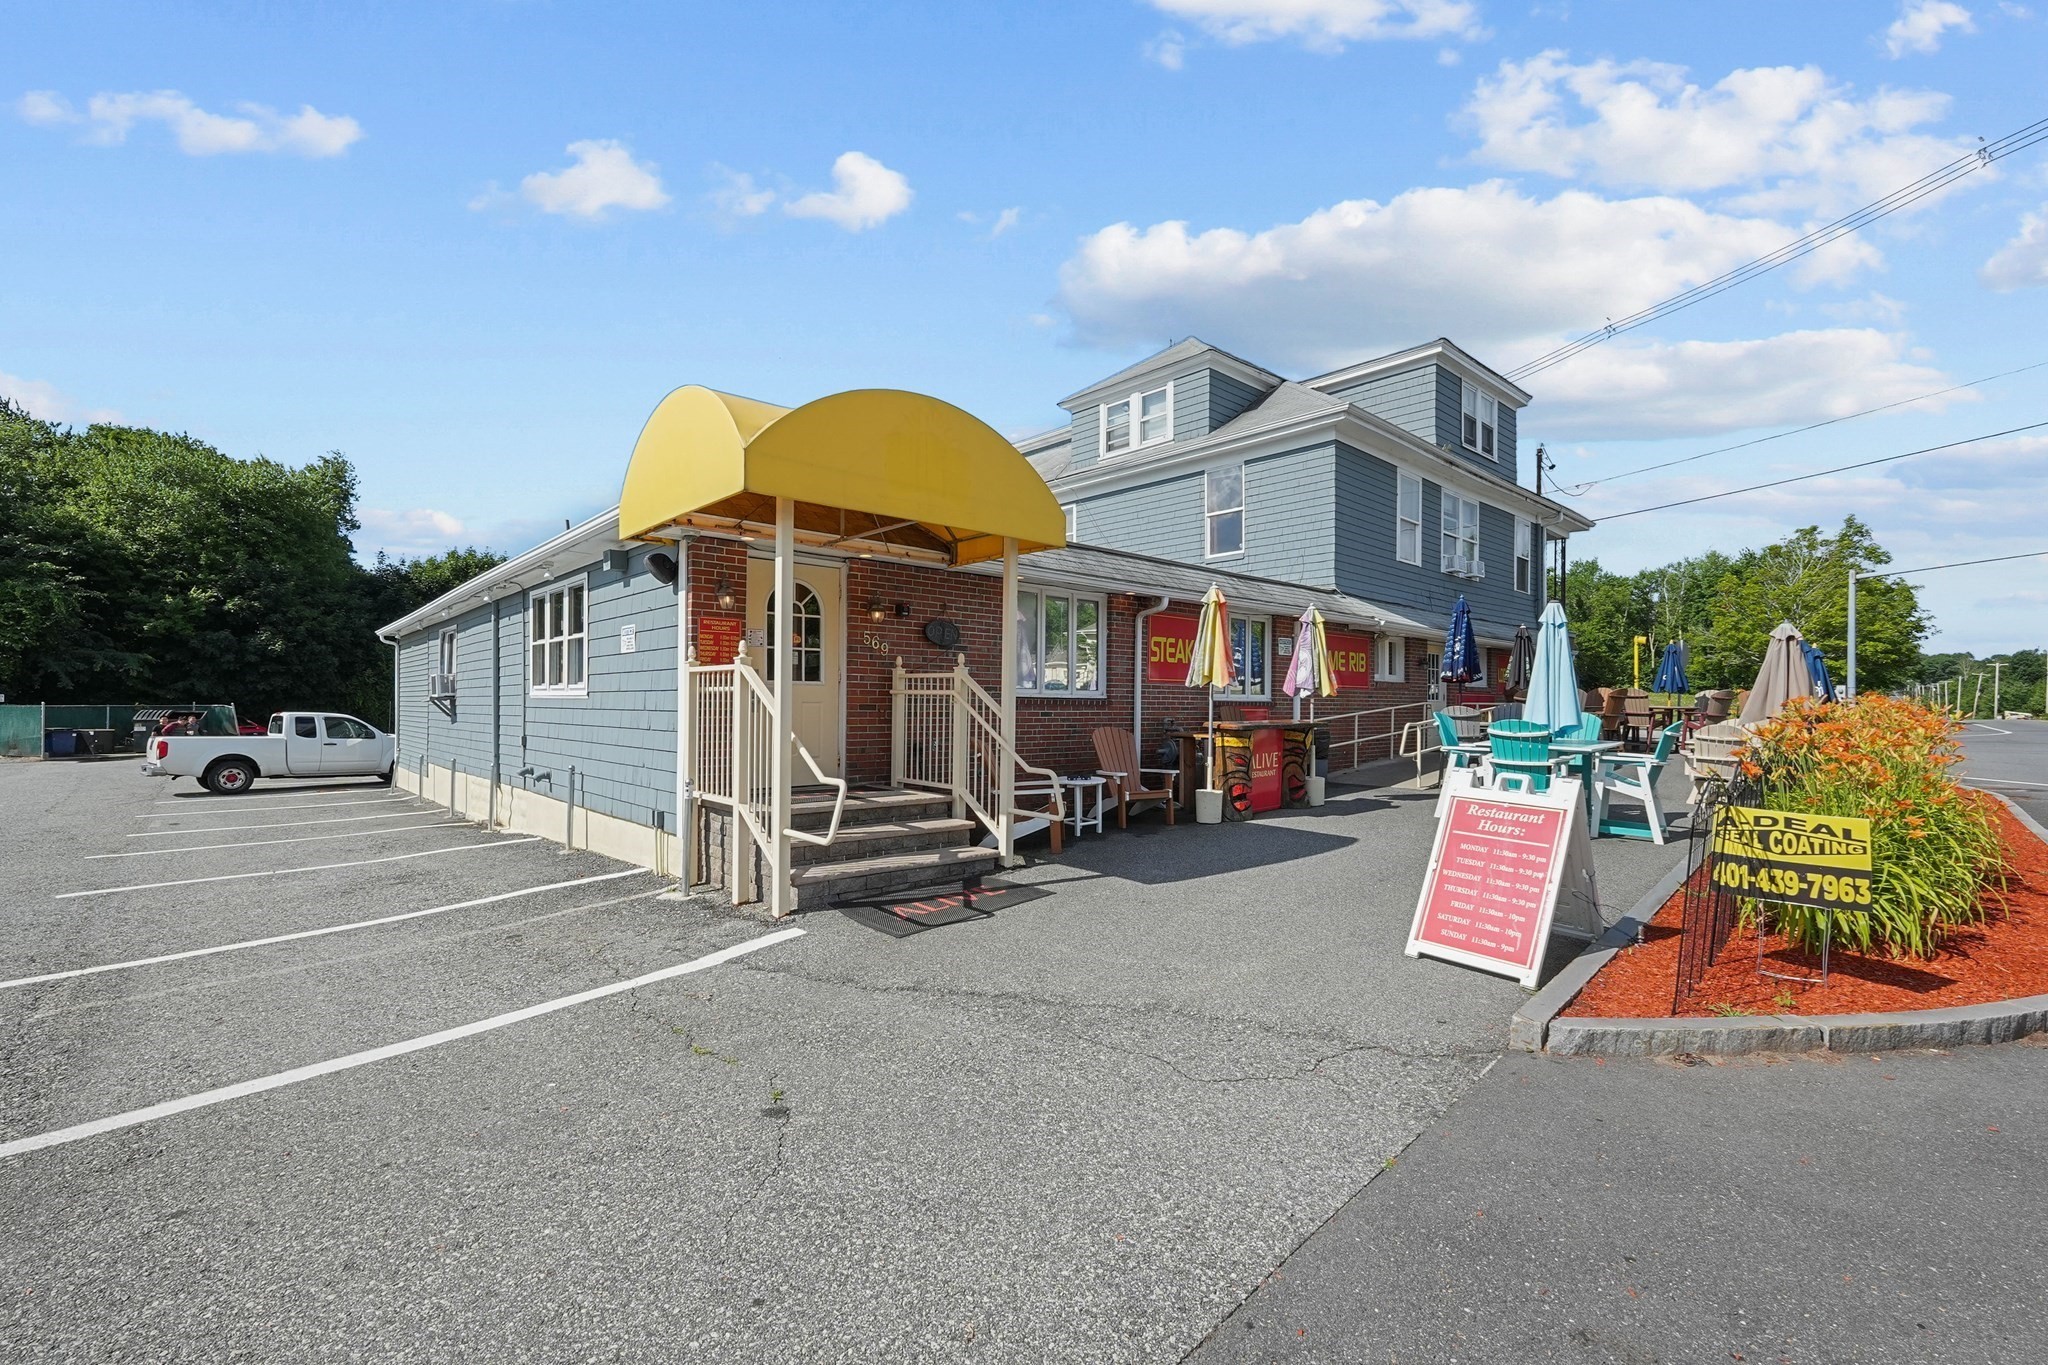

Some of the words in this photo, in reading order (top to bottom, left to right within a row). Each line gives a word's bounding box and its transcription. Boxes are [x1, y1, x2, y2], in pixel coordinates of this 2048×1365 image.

[927, 624, 959, 641] OPEN
[863, 631, 889, 656] 569
[1348, 651, 1367, 673] RIB
[1251, 770, 1277, 779] ESTAURANT
[1466, 803, 1546, 825] Restaurant
[1477, 819, 1526, 837] Hours:
[1717, 814, 1867, 843] A-DEAL
[1459, 842, 1489, 853] MONDAY
[1768, 830, 1866, 856] COATING
[1456, 856, 1486, 868] TUESDAY
[1442, 868, 1482, 882] WEDNESDAY
[1712, 861, 1872, 905] 401-439-7963
[1443, 883, 1479, 897] THURSDAY
[1450, 900, 1475, 911] FRIDAY
[1436, 912, 1471, 926] SATURDAY
[1440, 928, 1468, 940] SUNDAY
[1500, 943, 1515, 953] 9pm
